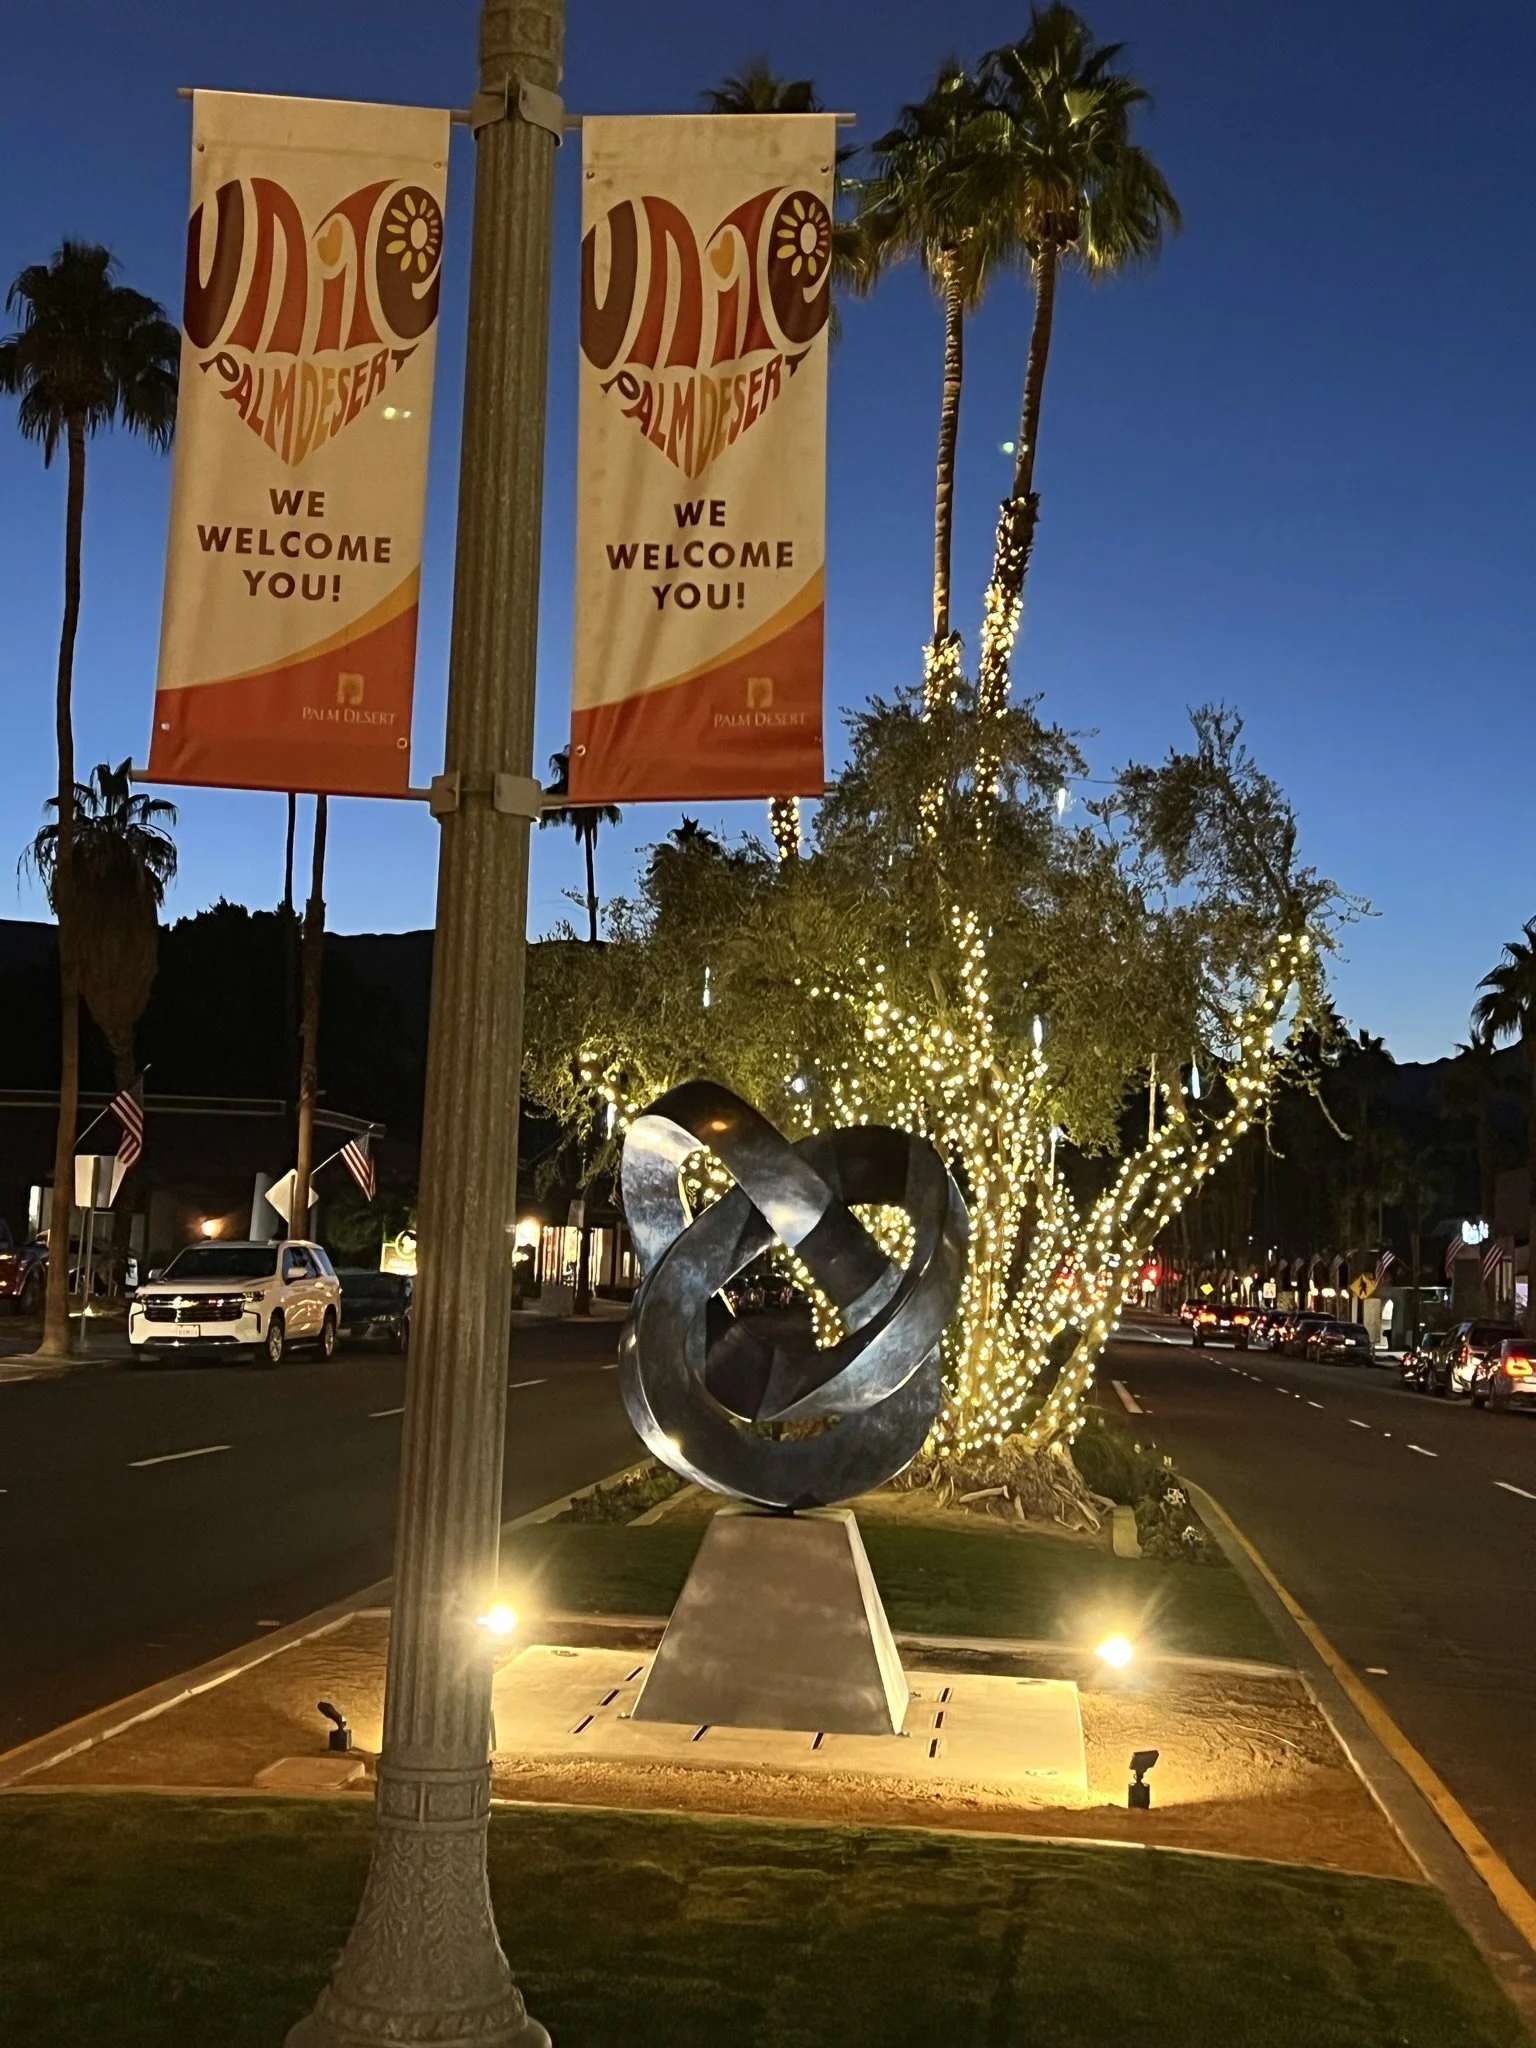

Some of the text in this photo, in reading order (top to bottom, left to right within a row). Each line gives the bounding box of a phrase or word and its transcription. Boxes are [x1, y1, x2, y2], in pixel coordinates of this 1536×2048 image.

[269, 488, 325, 518] WE
[674, 500, 726, 528] WE
[197, 524, 392, 564] WELCOME
[606, 540, 793, 570] WELCOME
[242, 569, 341, 602] YOU!
[652, 582, 745, 610] YOU!
